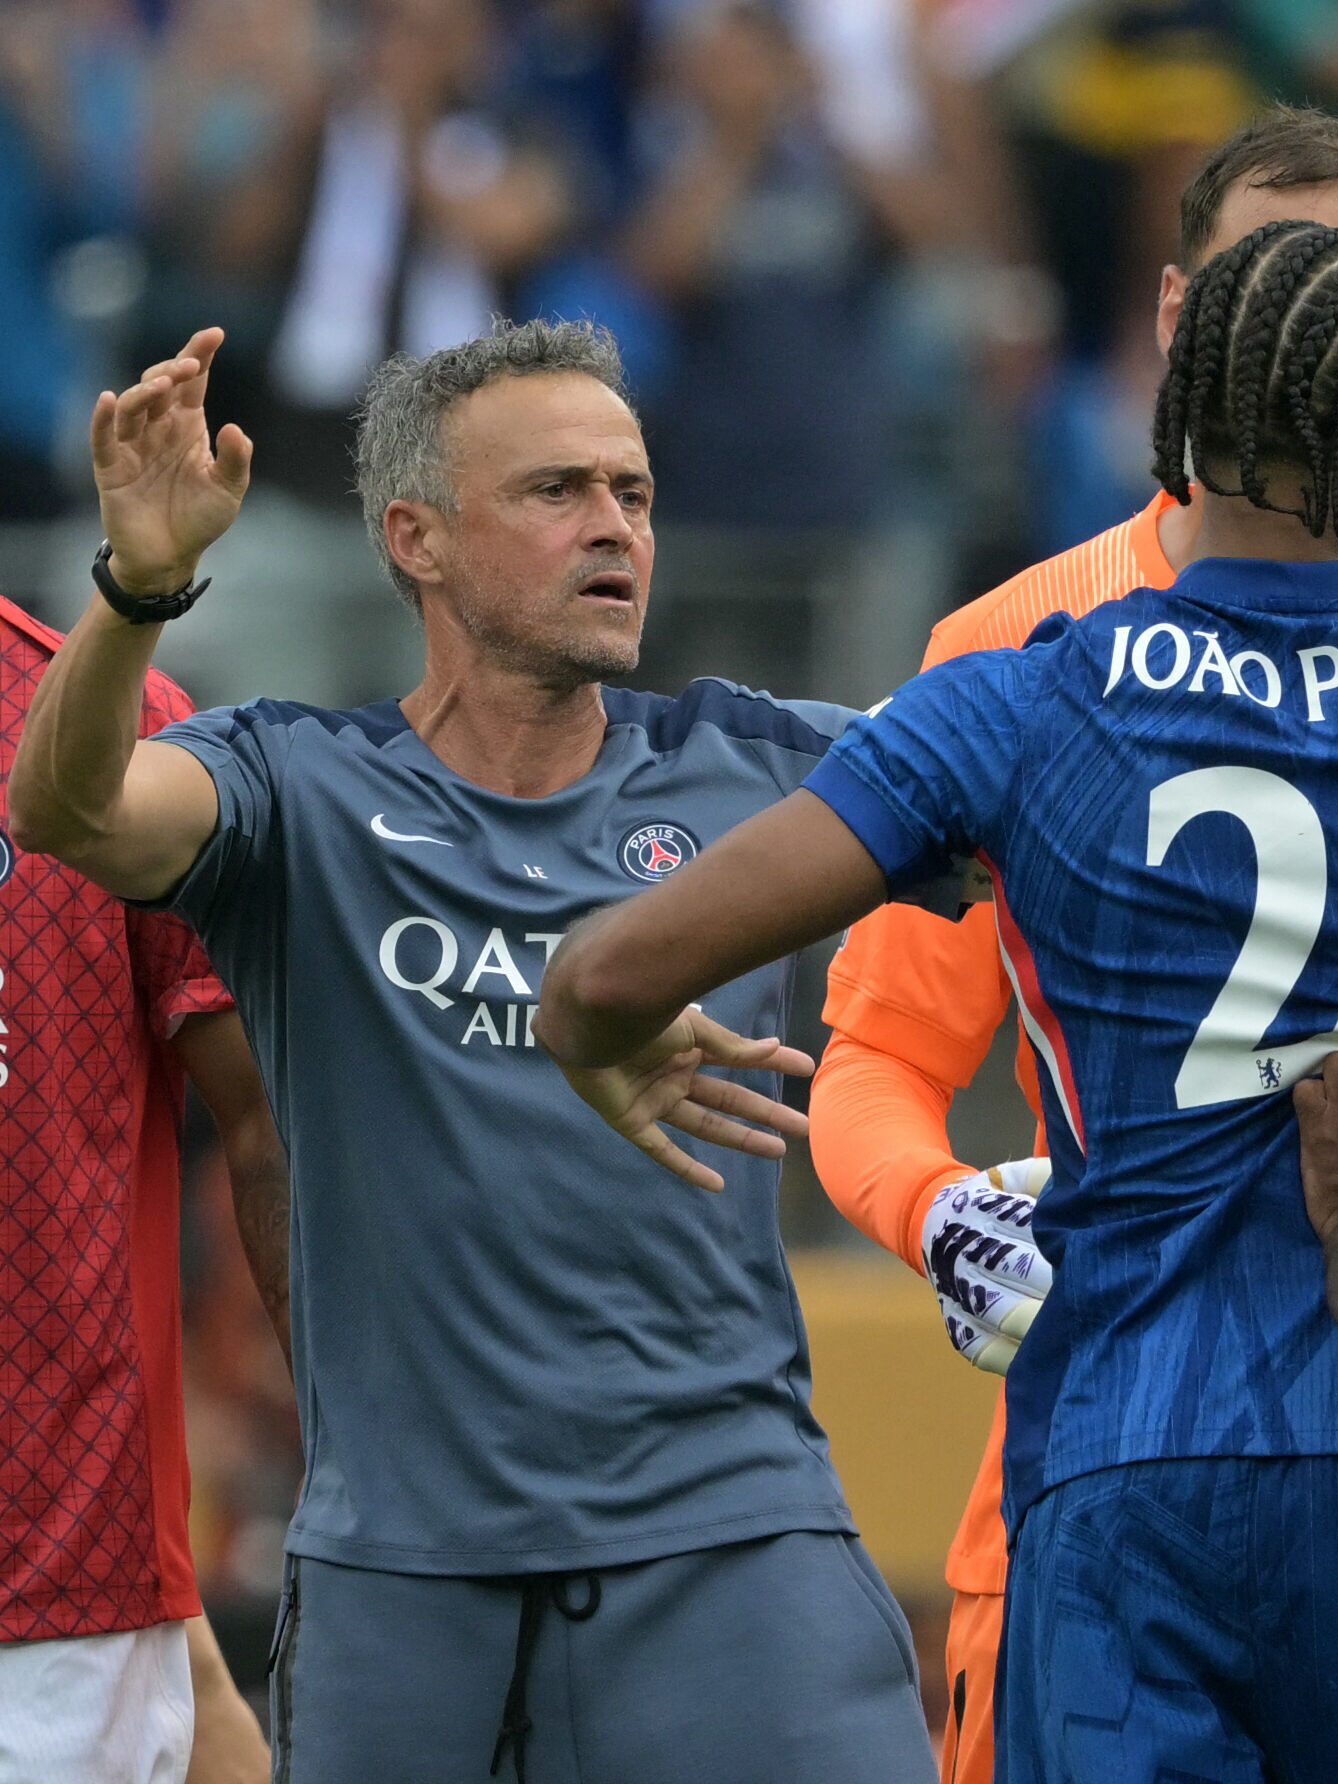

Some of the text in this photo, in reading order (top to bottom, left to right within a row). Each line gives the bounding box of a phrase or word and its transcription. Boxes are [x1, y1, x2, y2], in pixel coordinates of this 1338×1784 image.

[1103, 623, 1282, 708] JOÃO
[630, 828, 674, 850] PARIS
[523, 864, 548, 879] LE
[379, 916, 567, 1010] QAT
